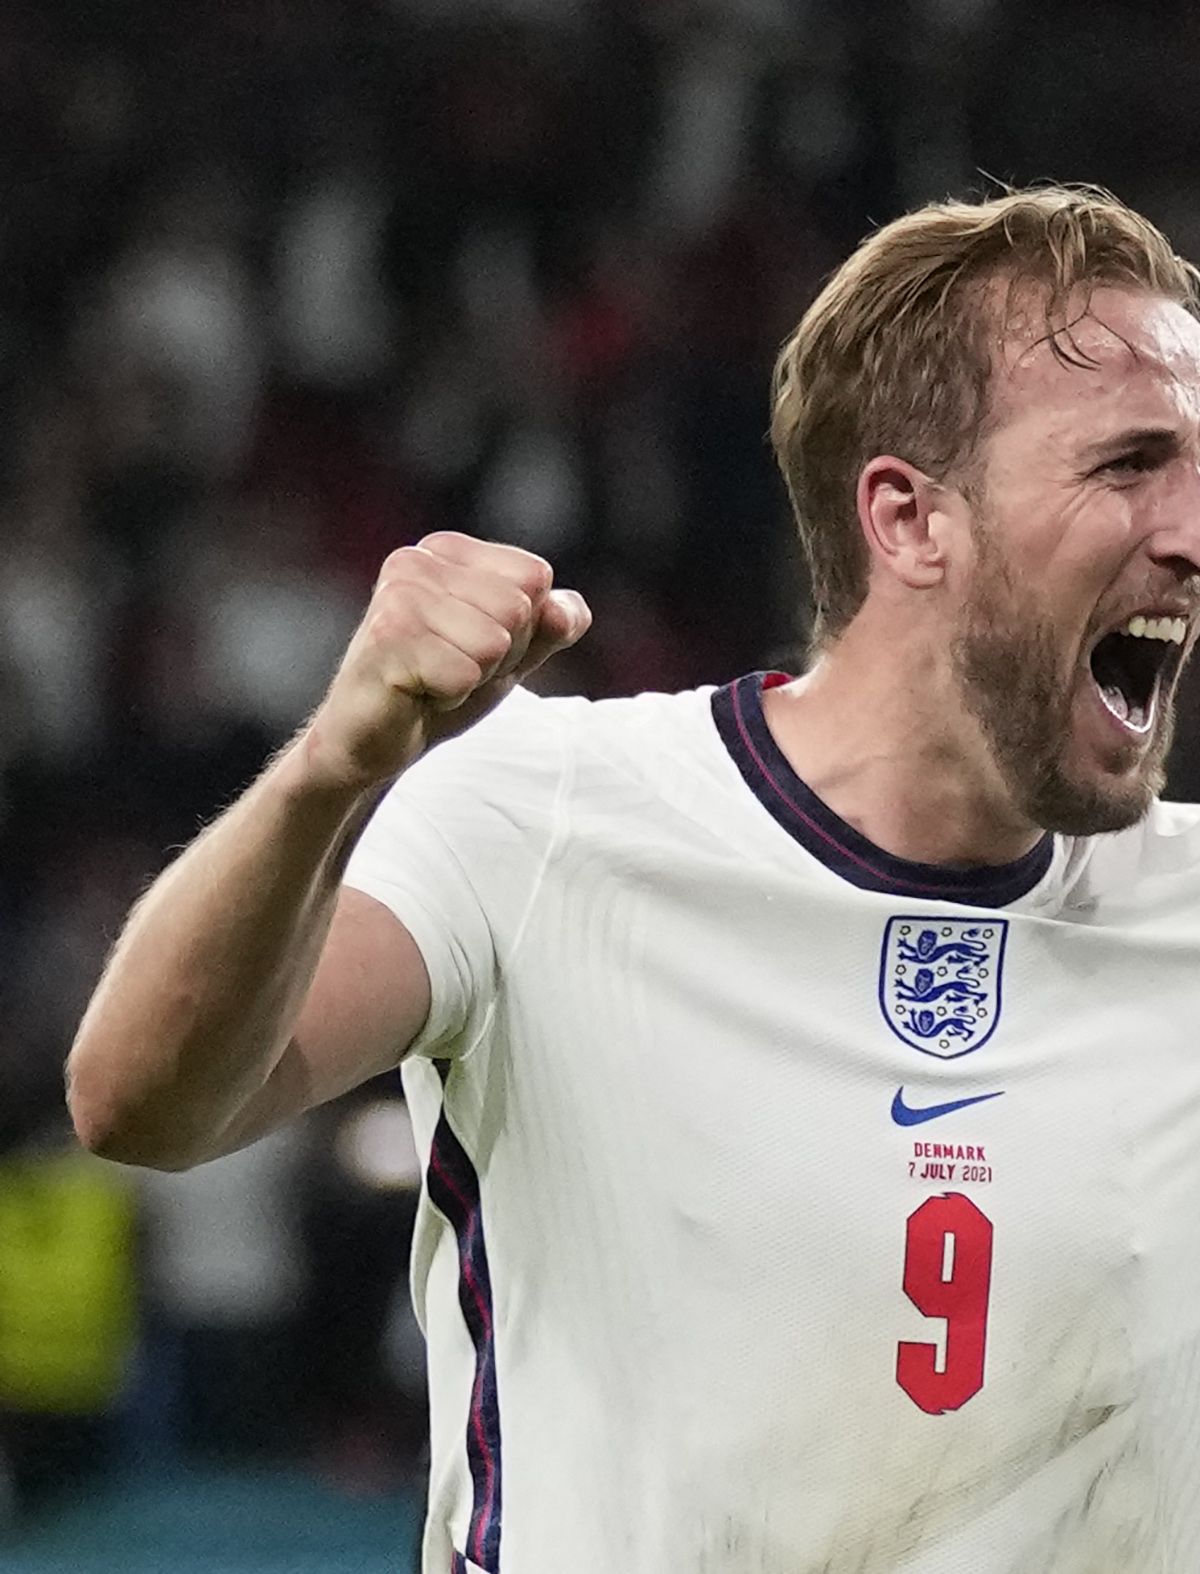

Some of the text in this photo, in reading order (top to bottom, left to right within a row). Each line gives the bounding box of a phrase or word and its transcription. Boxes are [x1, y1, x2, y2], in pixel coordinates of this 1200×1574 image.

[914, 1142, 986, 1161] DENMARK
[908, 1161, 992, 1183] 7 JULY 2021
[896, 1191, 993, 1415] 9
